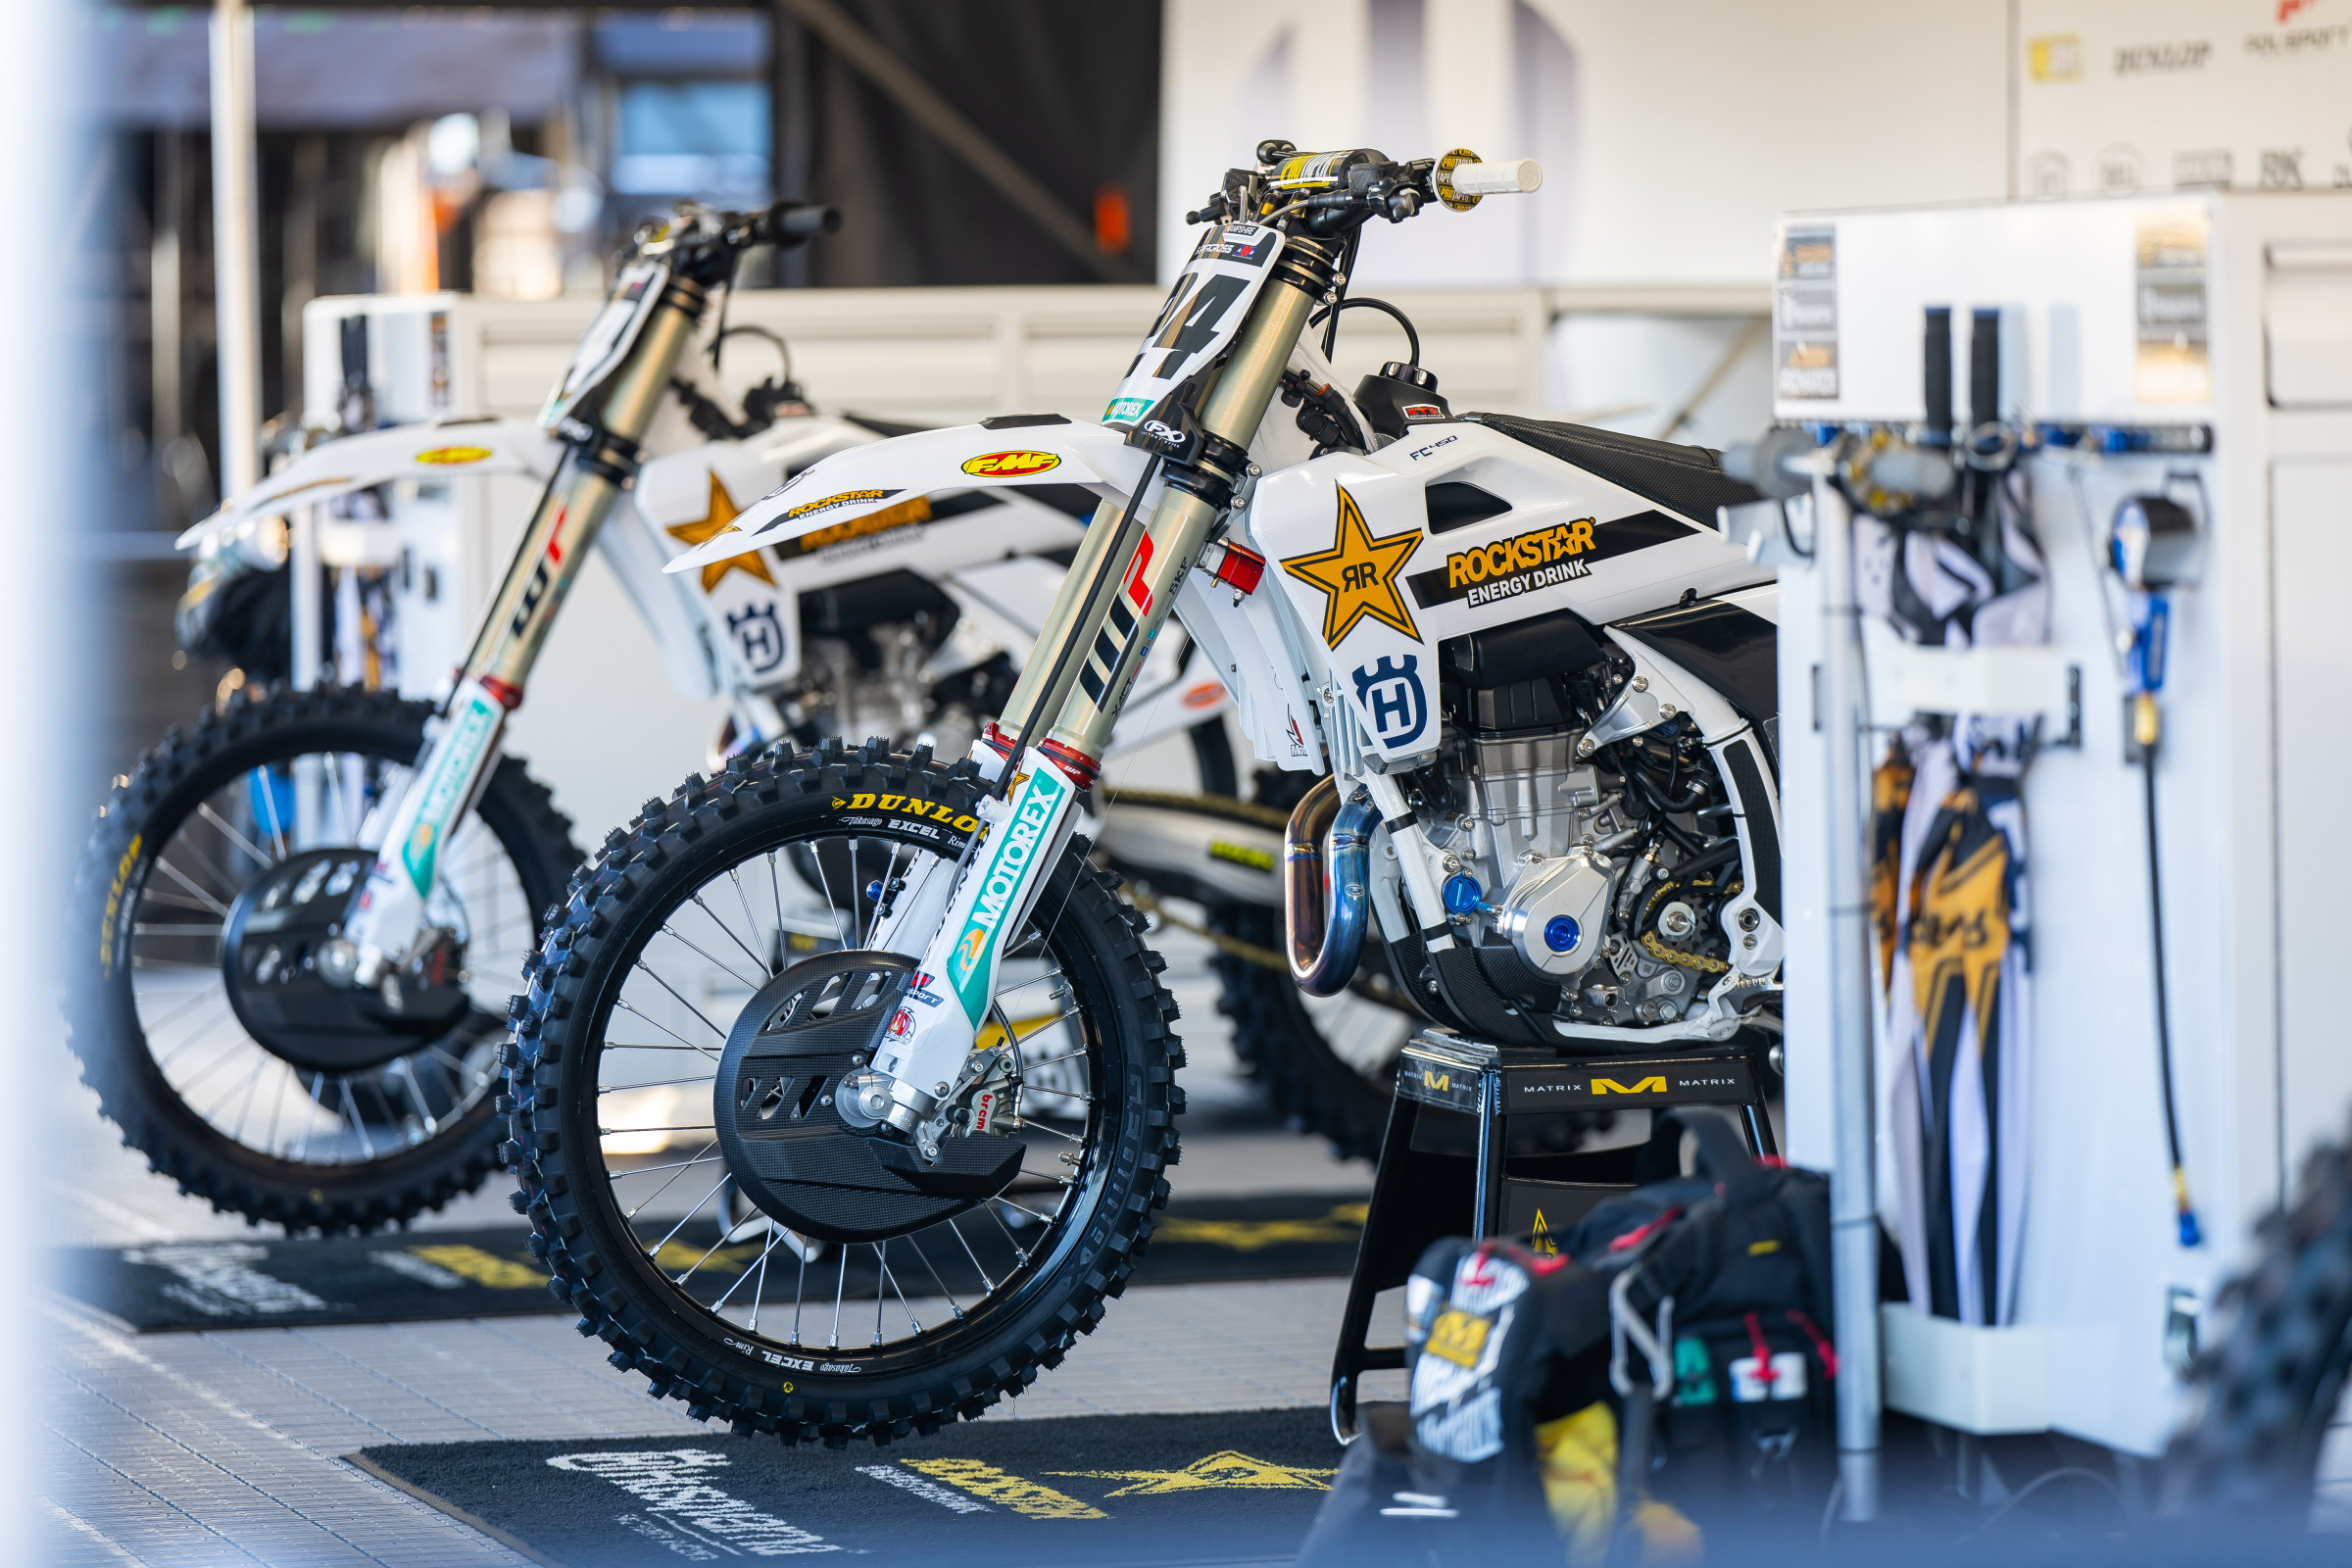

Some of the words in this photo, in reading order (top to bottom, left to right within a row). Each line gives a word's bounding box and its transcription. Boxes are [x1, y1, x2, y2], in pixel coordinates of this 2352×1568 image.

[965, 453, 1058, 474] FMF
[788, 489, 885, 517] ROCKSTAR
[798, 503, 841, 519] ENERGY
[842, 497, 879, 508] DRINK
[1448, 520, 1596, 588] ROCKSTAR
[1468, 573, 1531, 607] ENERGY
[1534, 559, 1589, 588] DRINK
[839, 816, 882, 827] Takasago
[888, 818, 941, 840] EXCEL
[972, 784, 1058, 930] MOTOREX
[1451, 1082, 1472, 1092] MATRIX
[1524, 1084, 1582, 1093] MATRIX
[1591, 1076, 1668, 1096] M
[1679, 1078, 1736, 1087] MATRIX
[735, 1341, 755, 1355] Rim
[761, 1350, 814, 1371] EXCEL
[820, 1362, 861, 1373] Takasago
